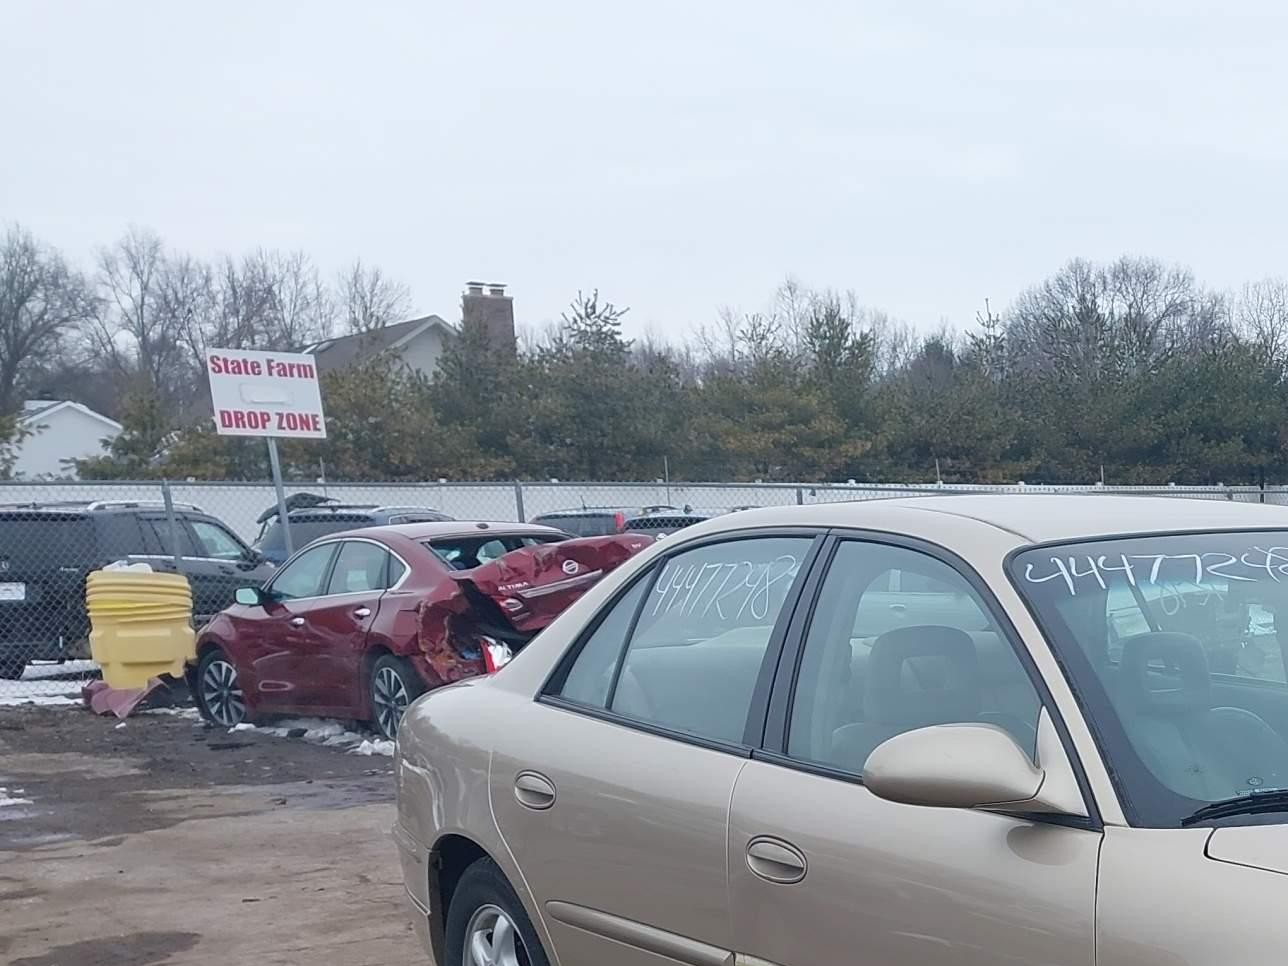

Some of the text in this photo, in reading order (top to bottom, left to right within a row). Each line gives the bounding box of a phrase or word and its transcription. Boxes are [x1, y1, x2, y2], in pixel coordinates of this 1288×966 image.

[209, 354, 315, 379] State Farm
[219, 409, 322, 432] DROP ZONE
